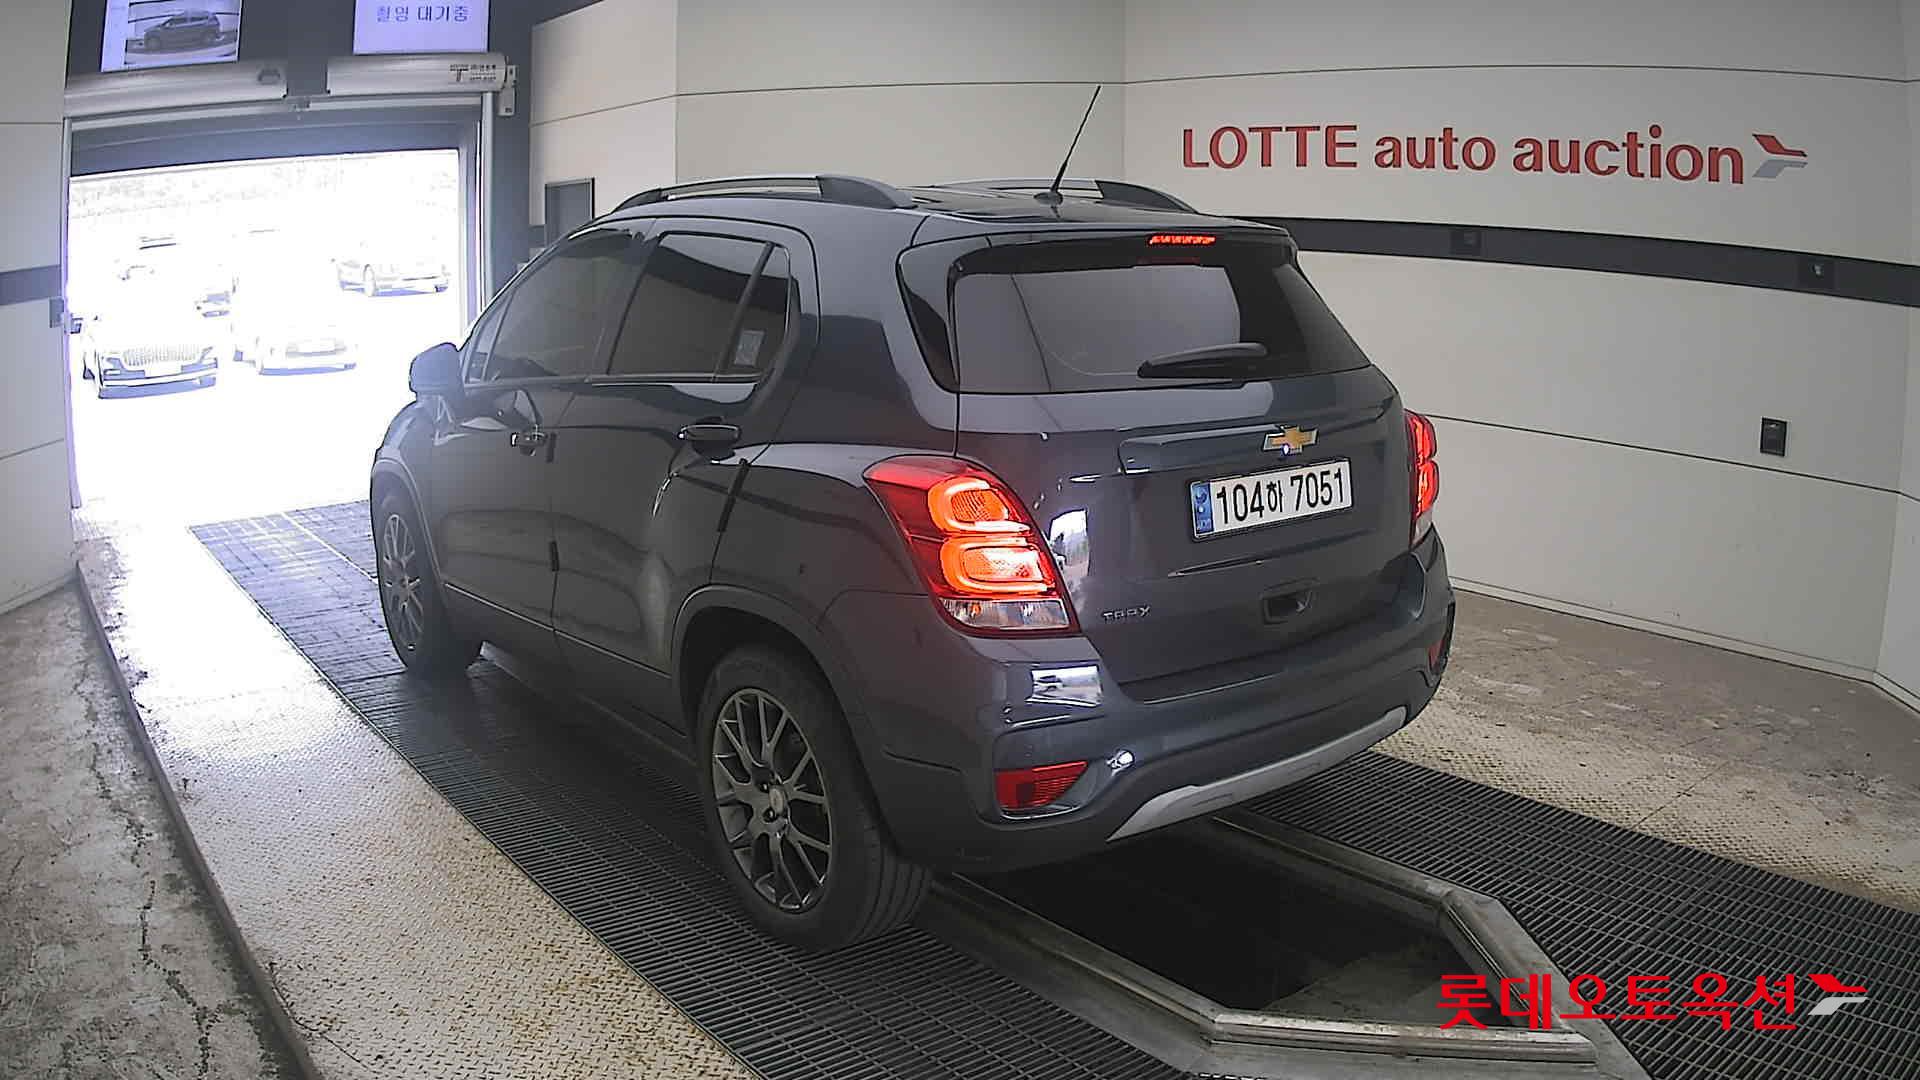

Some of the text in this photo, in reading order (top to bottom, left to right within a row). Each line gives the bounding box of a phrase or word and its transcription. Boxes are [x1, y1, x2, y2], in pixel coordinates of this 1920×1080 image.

[417, 5, 470, 22] 대기중
[1183, 124, 1744, 184] LOTTE auto auction
[1216, 467, 1344, 525] 104하 7051
